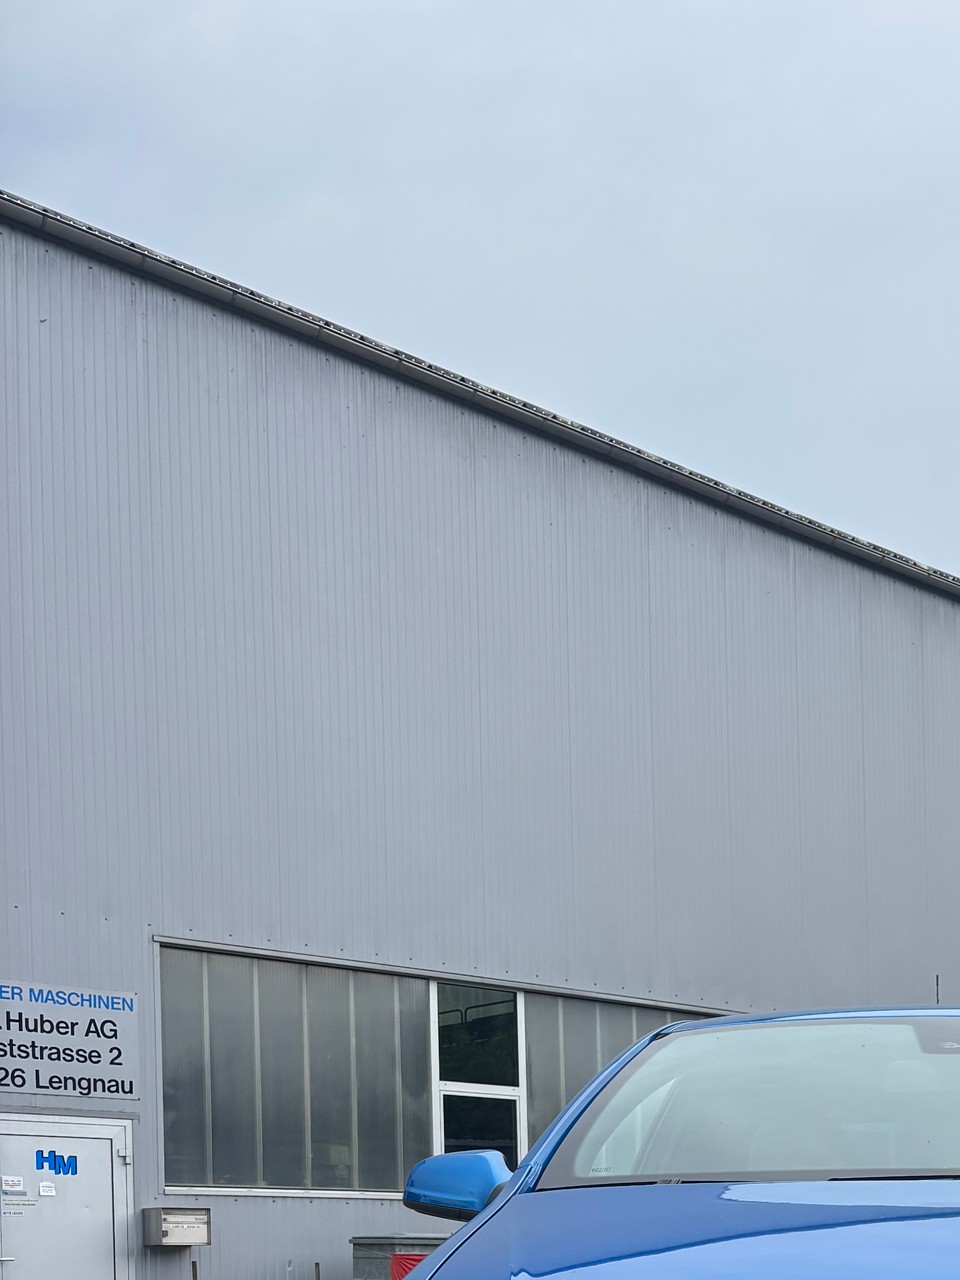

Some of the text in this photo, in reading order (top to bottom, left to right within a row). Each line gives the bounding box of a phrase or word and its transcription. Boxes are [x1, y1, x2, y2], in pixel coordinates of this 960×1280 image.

[0, 985, 134, 1012] ER MASCHINEN
[84, 1018, 118, 1039] AG
[108, 1046, 123, 1066] 2
[0, 1067, 134, 1096] 26 Lengnau
[36, 1150, 77, 1175] HM
